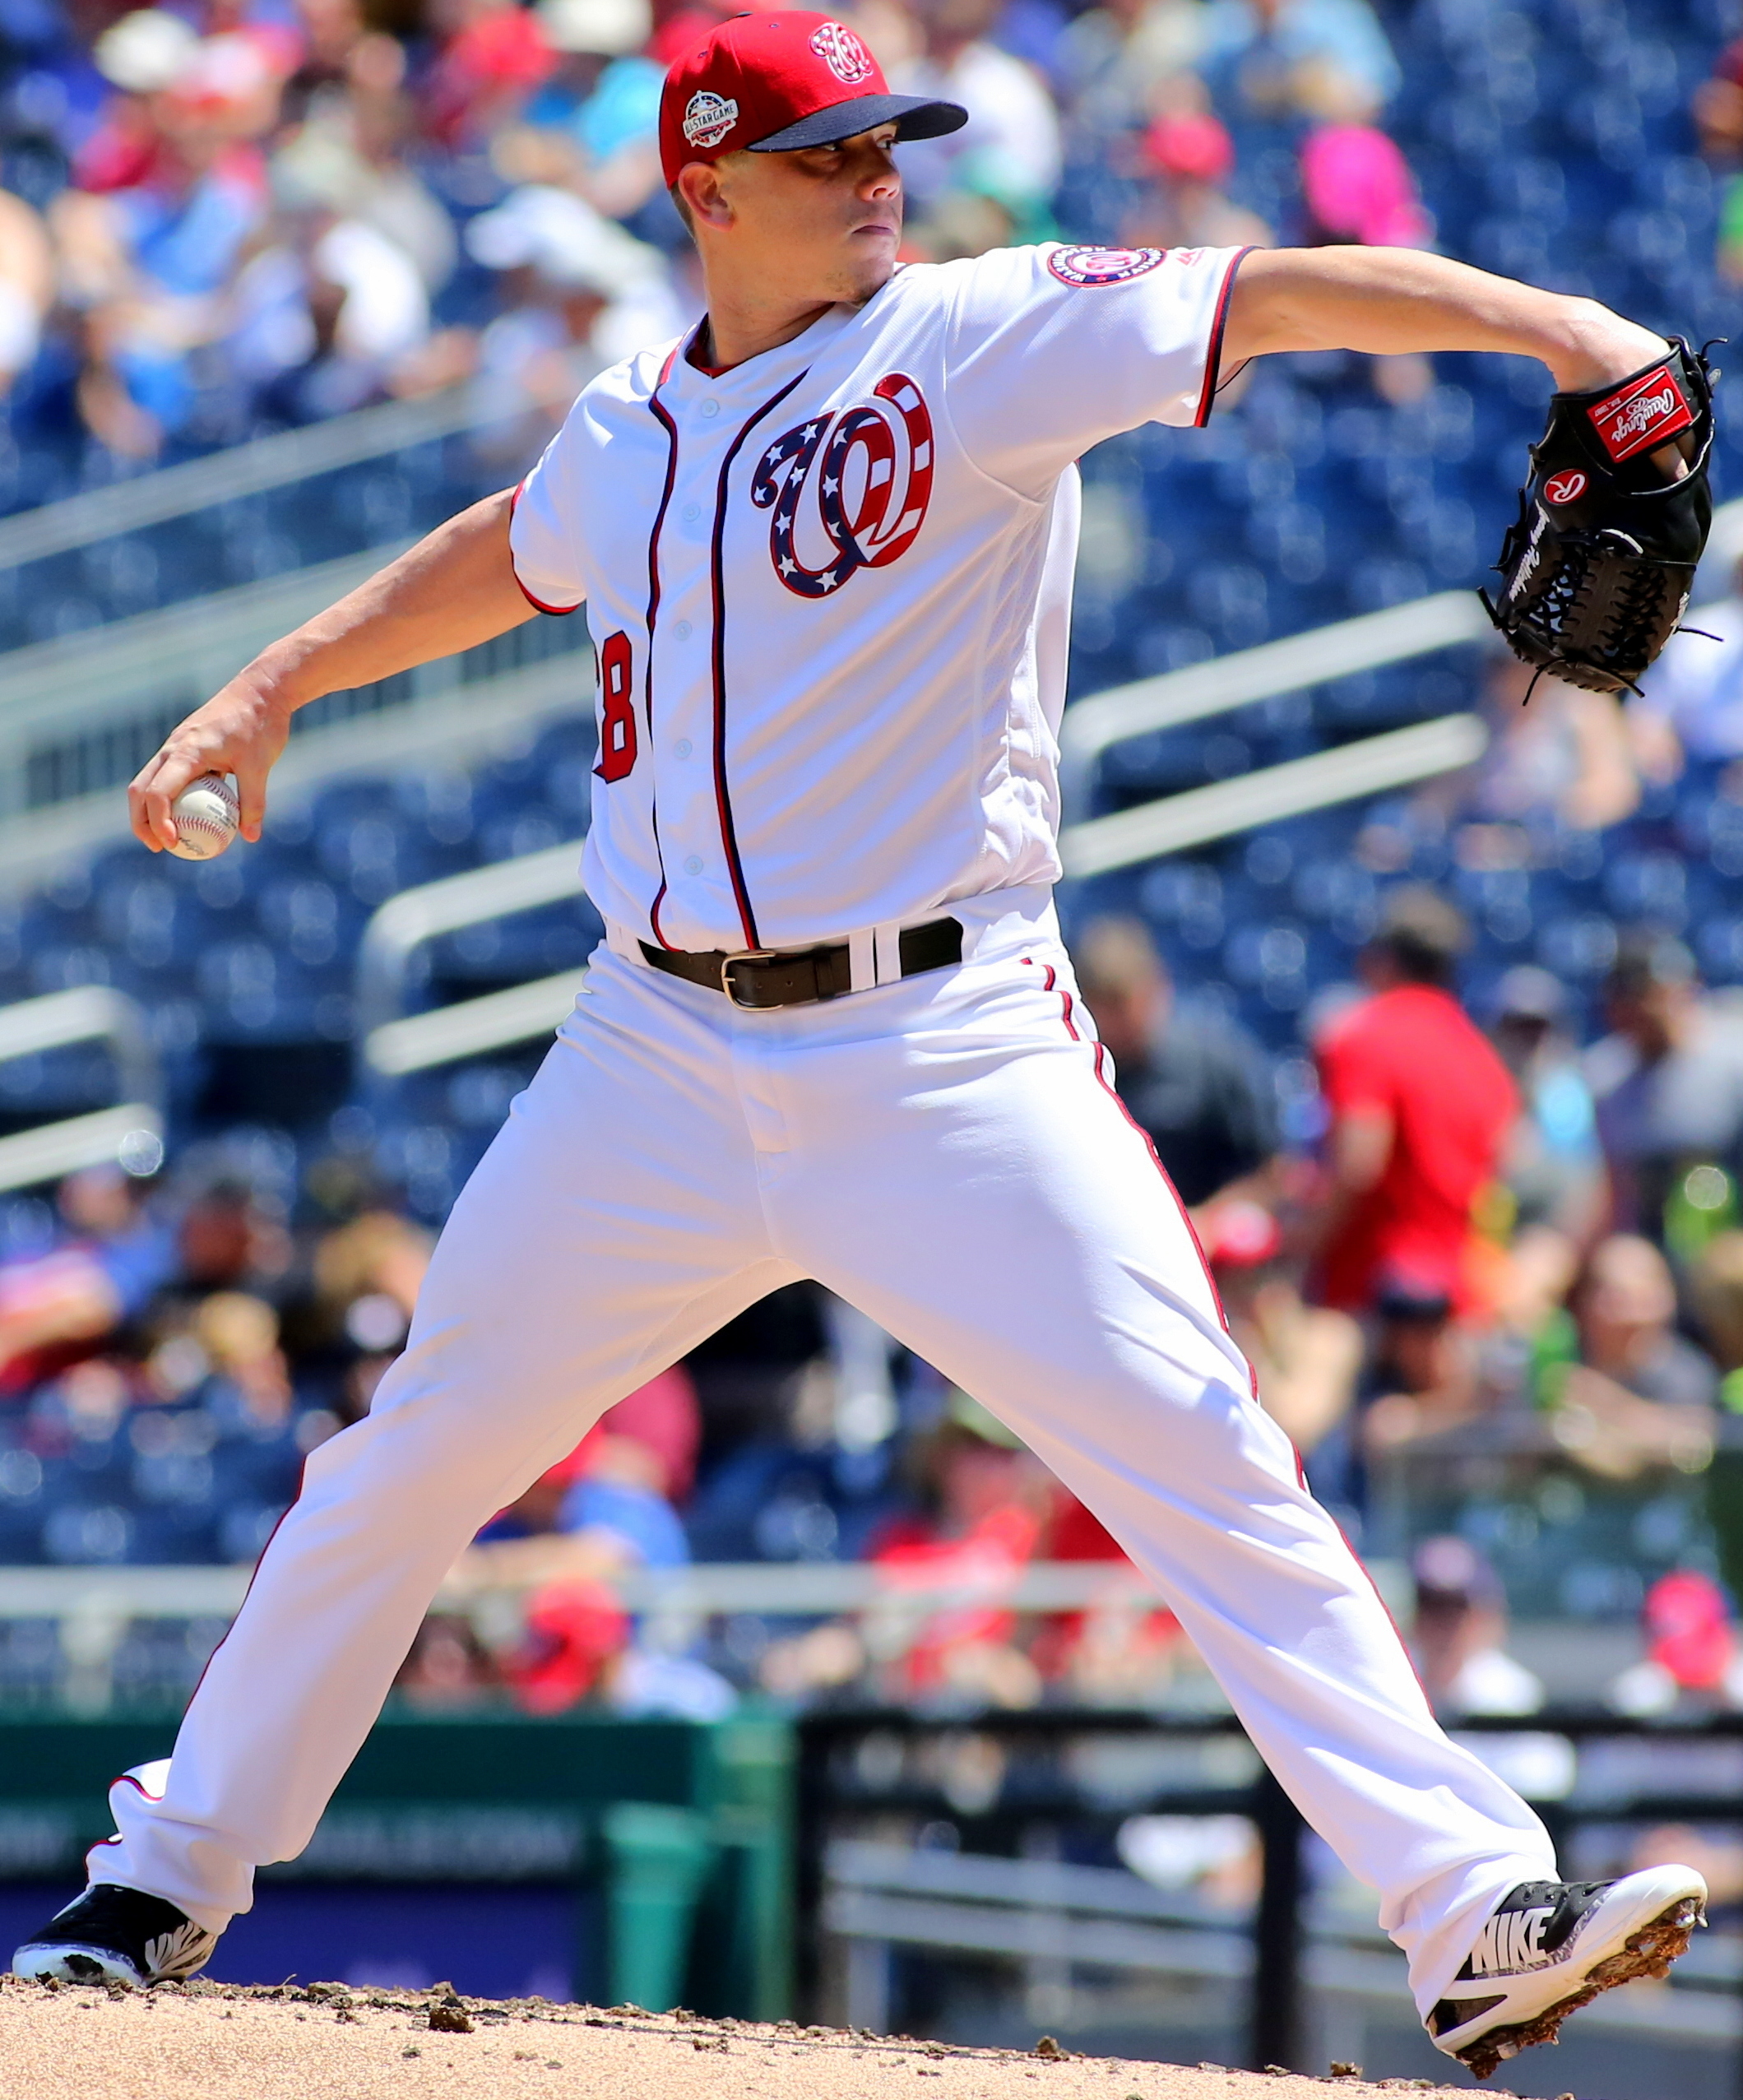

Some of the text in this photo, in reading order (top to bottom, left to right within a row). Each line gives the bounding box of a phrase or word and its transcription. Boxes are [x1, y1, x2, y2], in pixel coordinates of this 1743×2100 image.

[713, 104, 735, 121] GAME
[1611, 388, 1675, 443] Rawlings
[750, 371, 934, 599] W
[1549, 473, 1587, 503] R
[592, 630, 637, 784] 8
[1472, 1906, 1556, 1975] NIKE
